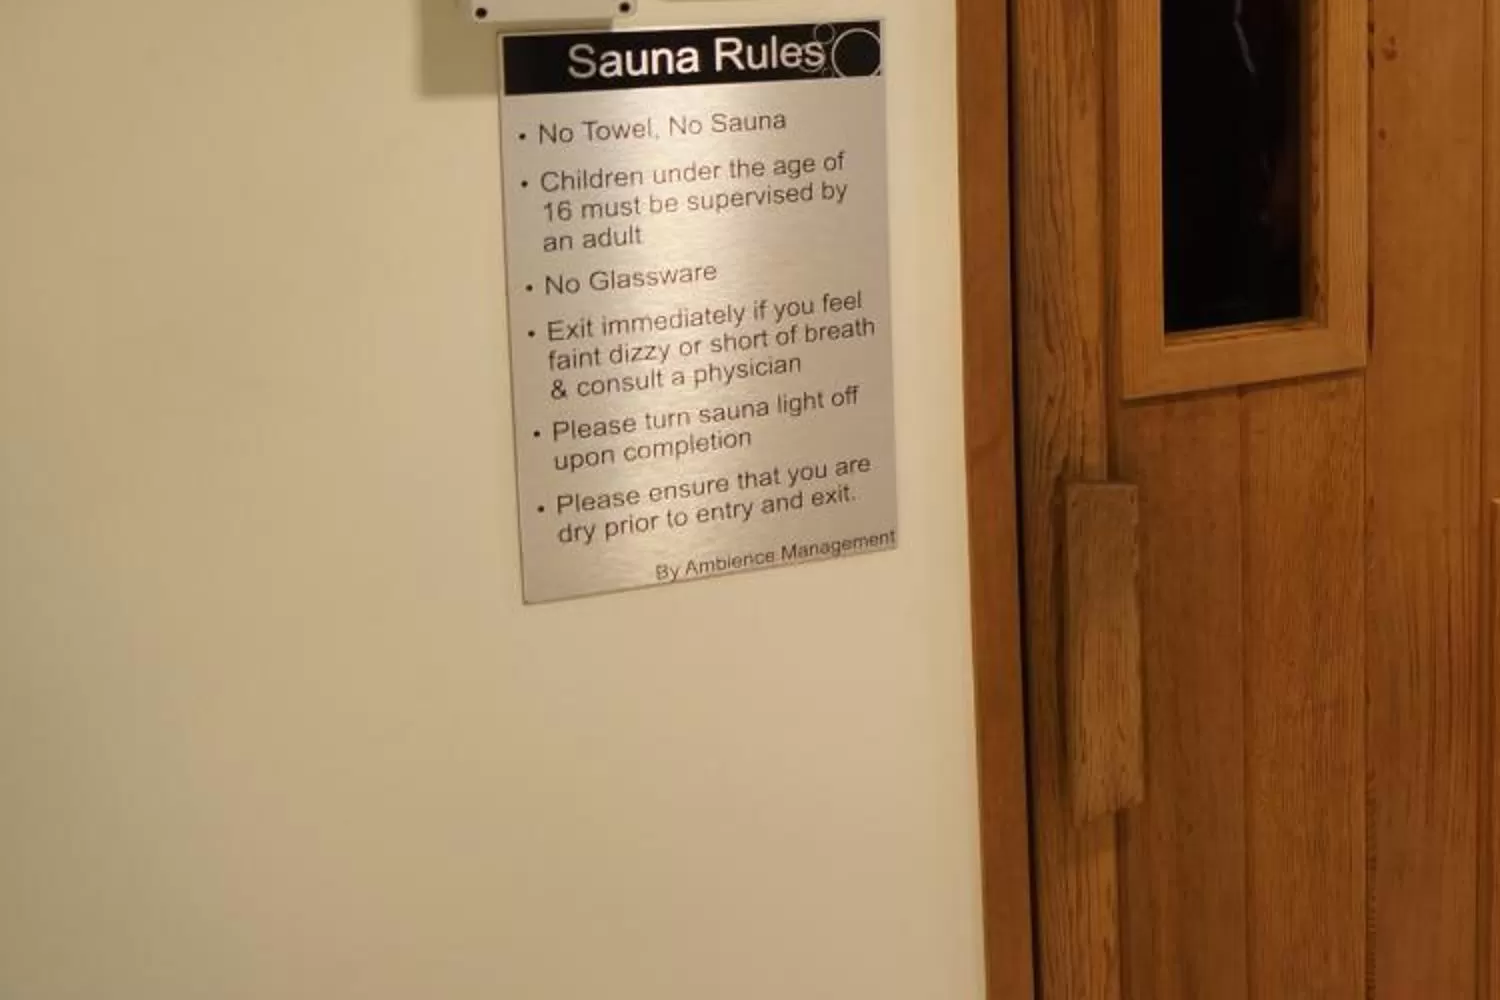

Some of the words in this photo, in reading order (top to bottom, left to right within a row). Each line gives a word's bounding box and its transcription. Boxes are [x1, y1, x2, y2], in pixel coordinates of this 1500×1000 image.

[568, 43, 699, 79] Sauna
[714, 36, 825, 73] Rules
[538, 124, 574, 144] No
[582, 118, 660, 142] Towel,
[669, 116, 702, 136] No
[711, 112, 786, 133] Sauna
[540, 167, 643, 193] Children
[653, 162, 721, 186] under
[730, 159, 765, 179] the
[773, 156, 816, 179] age
[824, 151, 845, 171] of
[543, 200, 572, 221] 16
[580, 199, 641, 219] must
[650, 195, 679, 214] be
[687, 181, 813, 215] supervised
[822, 181, 848, 204] by
[543, 234, 573, 252] an
[583, 225, 642, 249] adult
[545, 276, 580, 296] No
[589, 263, 717, 292] Glassware
[547, 318, 593, 342] Exit
[602, 304, 745, 337] immediately
[754, 300, 769, 320] if
[774, 299, 815, 324] you
[822, 292, 862, 313] feel
[549, 348, 601, 371] faint
[609, 341, 670, 366] dizzy
[679, 340, 701, 357] or
[710, 331, 768, 353] short
[776, 326, 799, 345] of
[805, 318, 875, 343] breath
[550, 380, 567, 401] &
[577, 369, 663, 397] consult
[671, 370, 686, 386] a
[694, 355, 801, 388] physician
[553, 415, 637, 441] Please
[645, 408, 690, 429] turn
[699, 398, 769, 425] sauna
[777, 390, 824, 418] light
[831, 385, 860, 407] off
[554, 446, 615, 473] upon
[623, 428, 752, 463] completion
[556, 488, 640, 514] Please
[648, 475, 729, 502] ensure
[737, 465, 780, 489] that
[787, 458, 828, 485] you
[835, 456, 871, 475] are
[558, 522, 595, 546] dry
[604, 514, 660, 540] prior
[666, 510, 688, 528] to
[697, 501, 754, 524] entry
[761, 490, 802, 514] and
[811, 484, 857, 507] exit.
[655, 564, 680, 582] By
[685, 552, 775, 576] Ambience
[781, 530, 896, 562] Management
